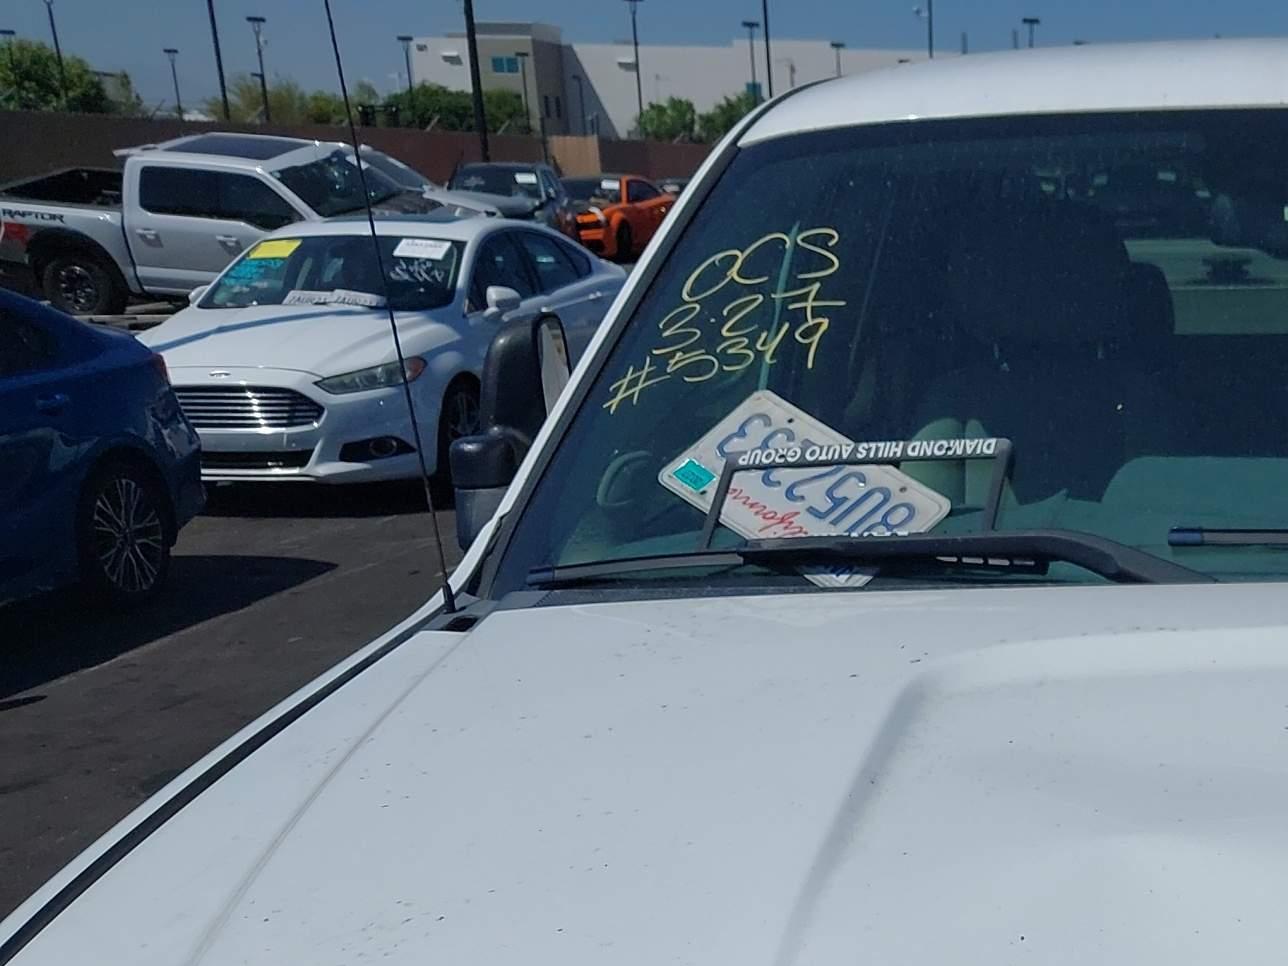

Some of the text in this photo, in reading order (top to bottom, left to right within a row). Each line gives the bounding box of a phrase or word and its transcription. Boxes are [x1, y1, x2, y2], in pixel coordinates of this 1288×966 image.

[2, 208, 66, 224] RAPTOR
[602, 317, 831, 415] #5349
[738, 438, 997, 466] DIAMOND HILLS AUTO GROUP
